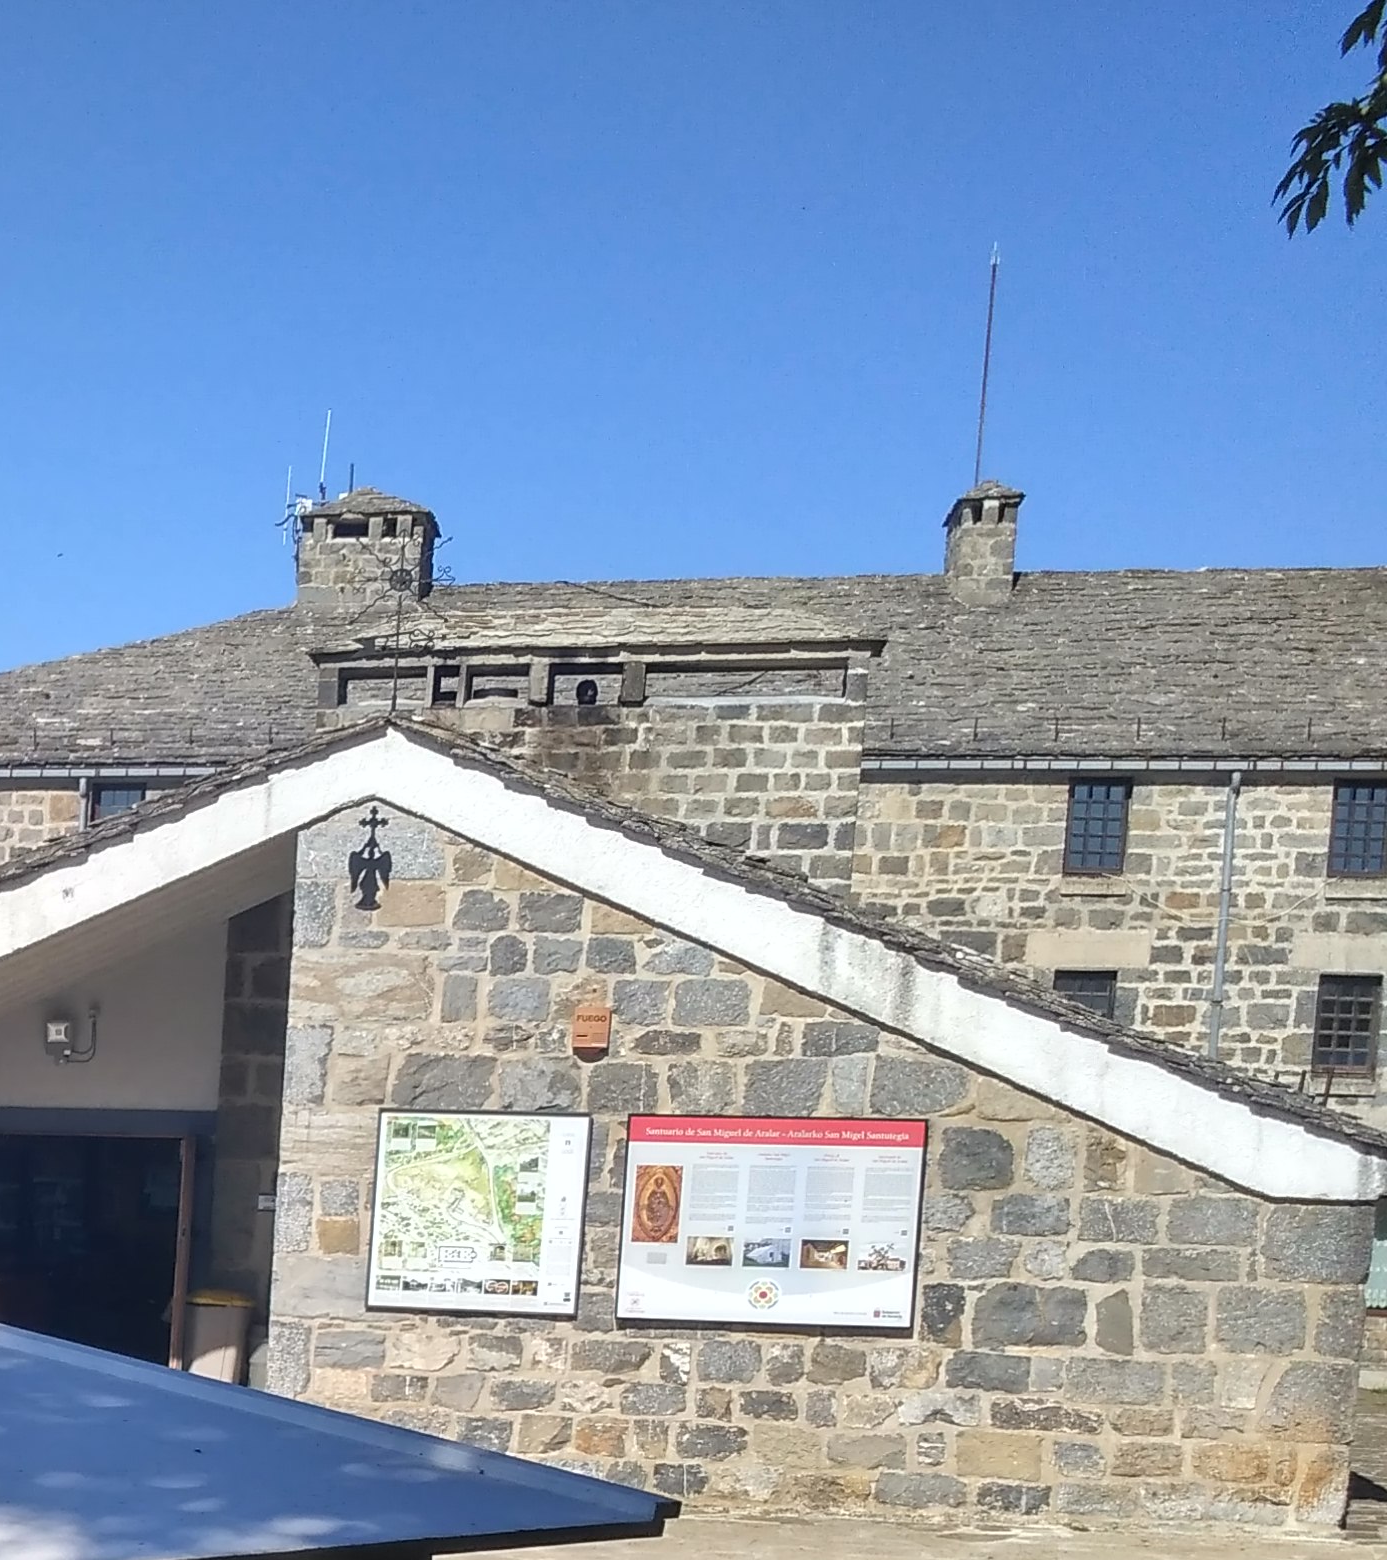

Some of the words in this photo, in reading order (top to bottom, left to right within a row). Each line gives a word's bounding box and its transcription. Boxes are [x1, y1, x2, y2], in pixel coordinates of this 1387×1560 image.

[646, 1127, 683, 1135] Santuario
[685, 1128, 695, 1136] de
[697, 1128, 711, 1136] San
[714, 1129, 741, 1138] Miguel
[755, 1129, 779, 1137] Aralar
[787, 1130, 823, 1138] Aralarko
[825, 1131, 839, 1139] San
[842, 1131, 864, 1140] Migel
[866, 1131, 909, 1142] Santutegia
